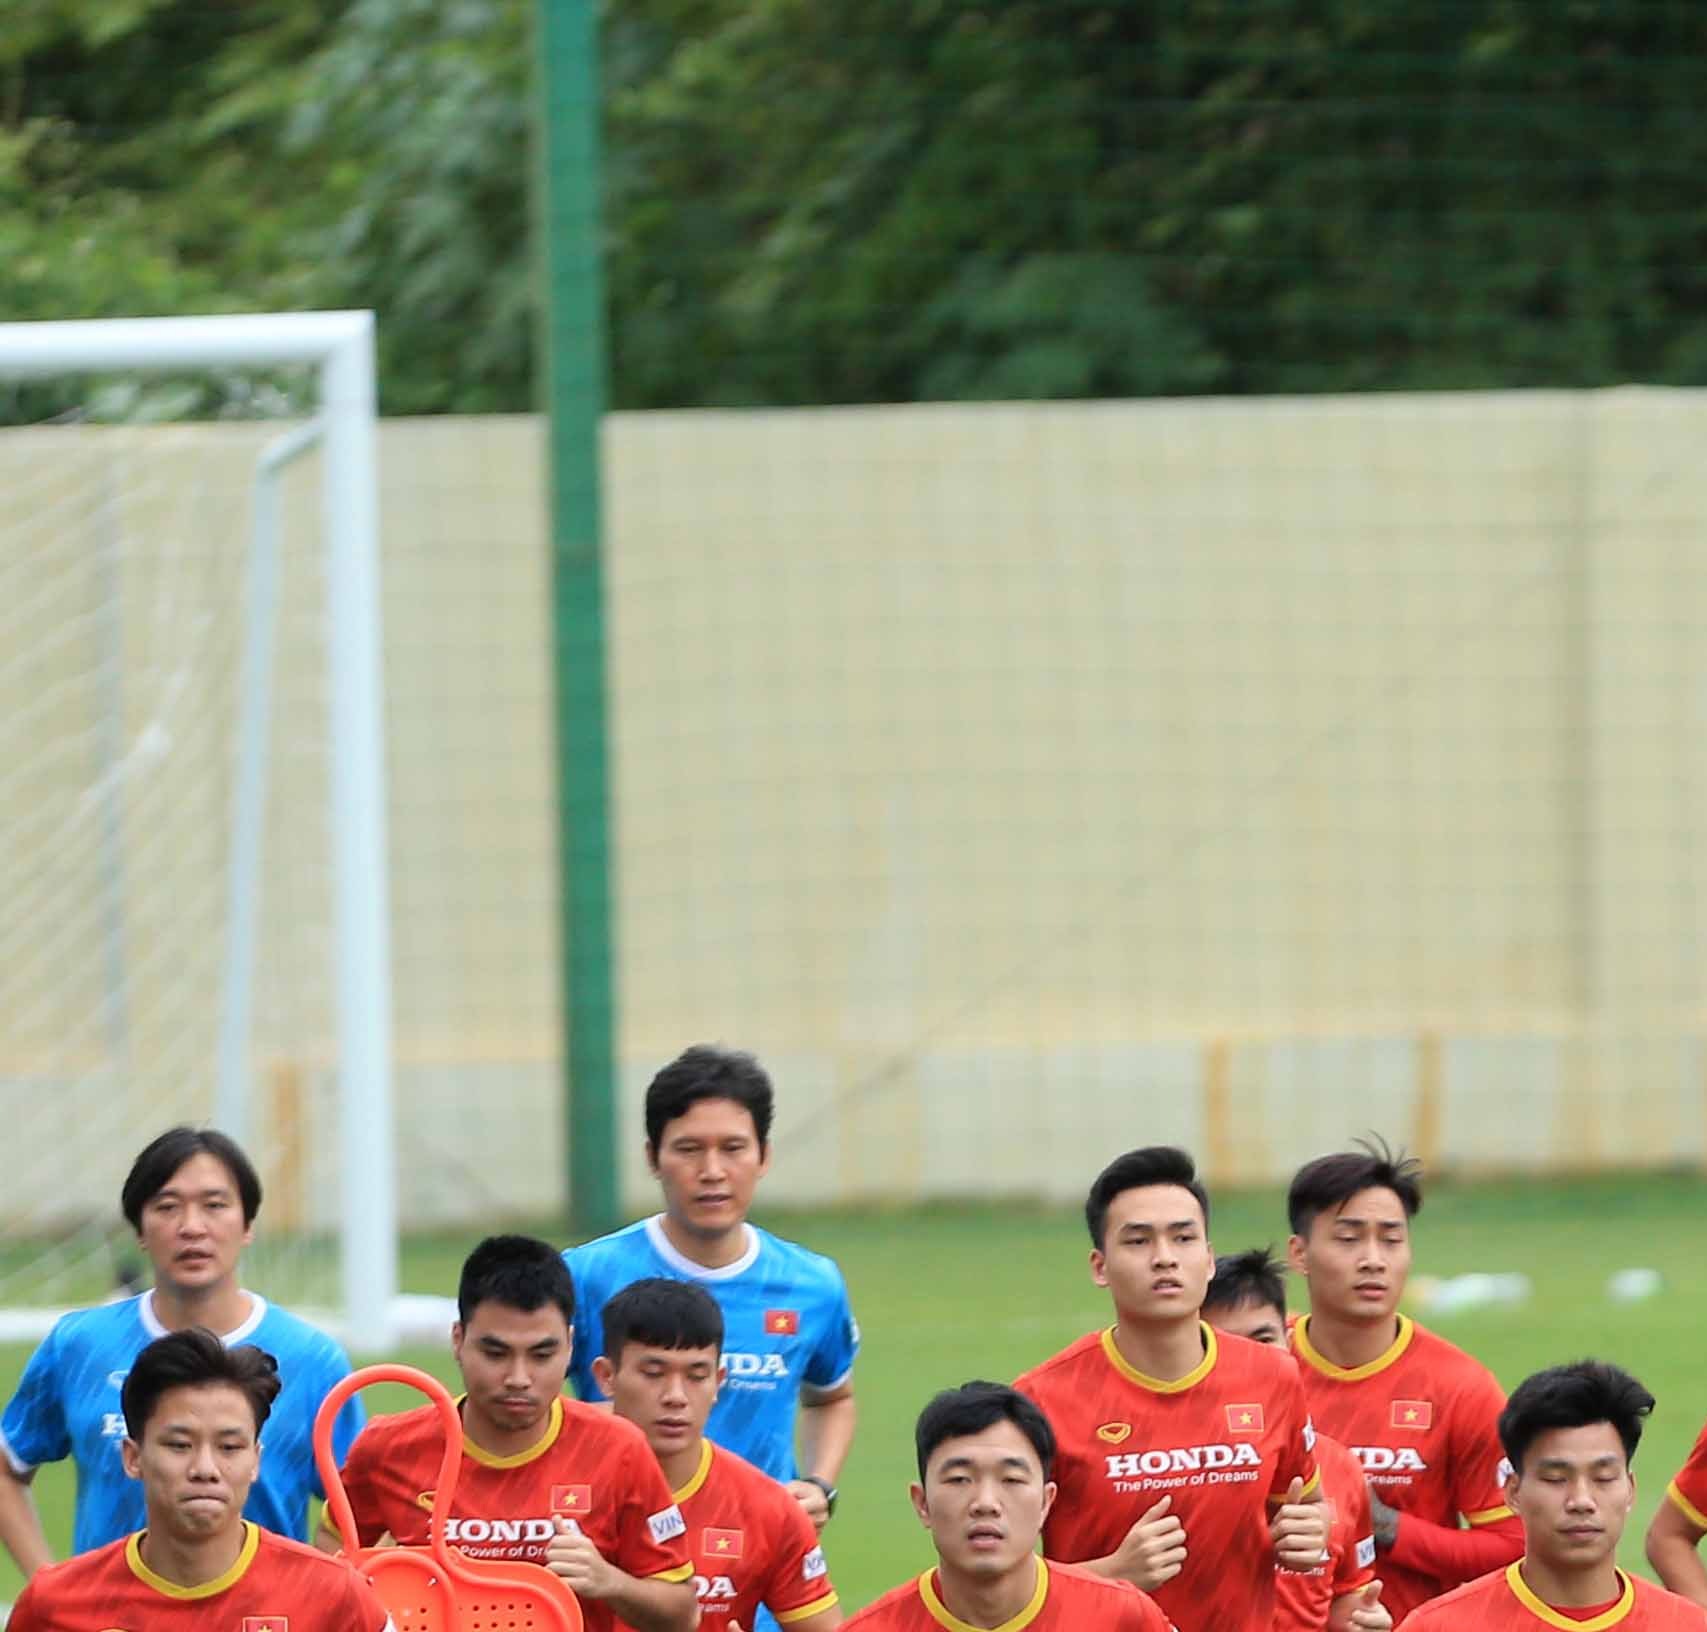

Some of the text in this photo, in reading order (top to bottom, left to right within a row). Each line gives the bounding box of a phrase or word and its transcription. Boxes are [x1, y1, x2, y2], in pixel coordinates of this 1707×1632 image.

[1105, 1443, 1262, 1478] HONDA
[1114, 1470, 1259, 1493] The Power of Dreams
